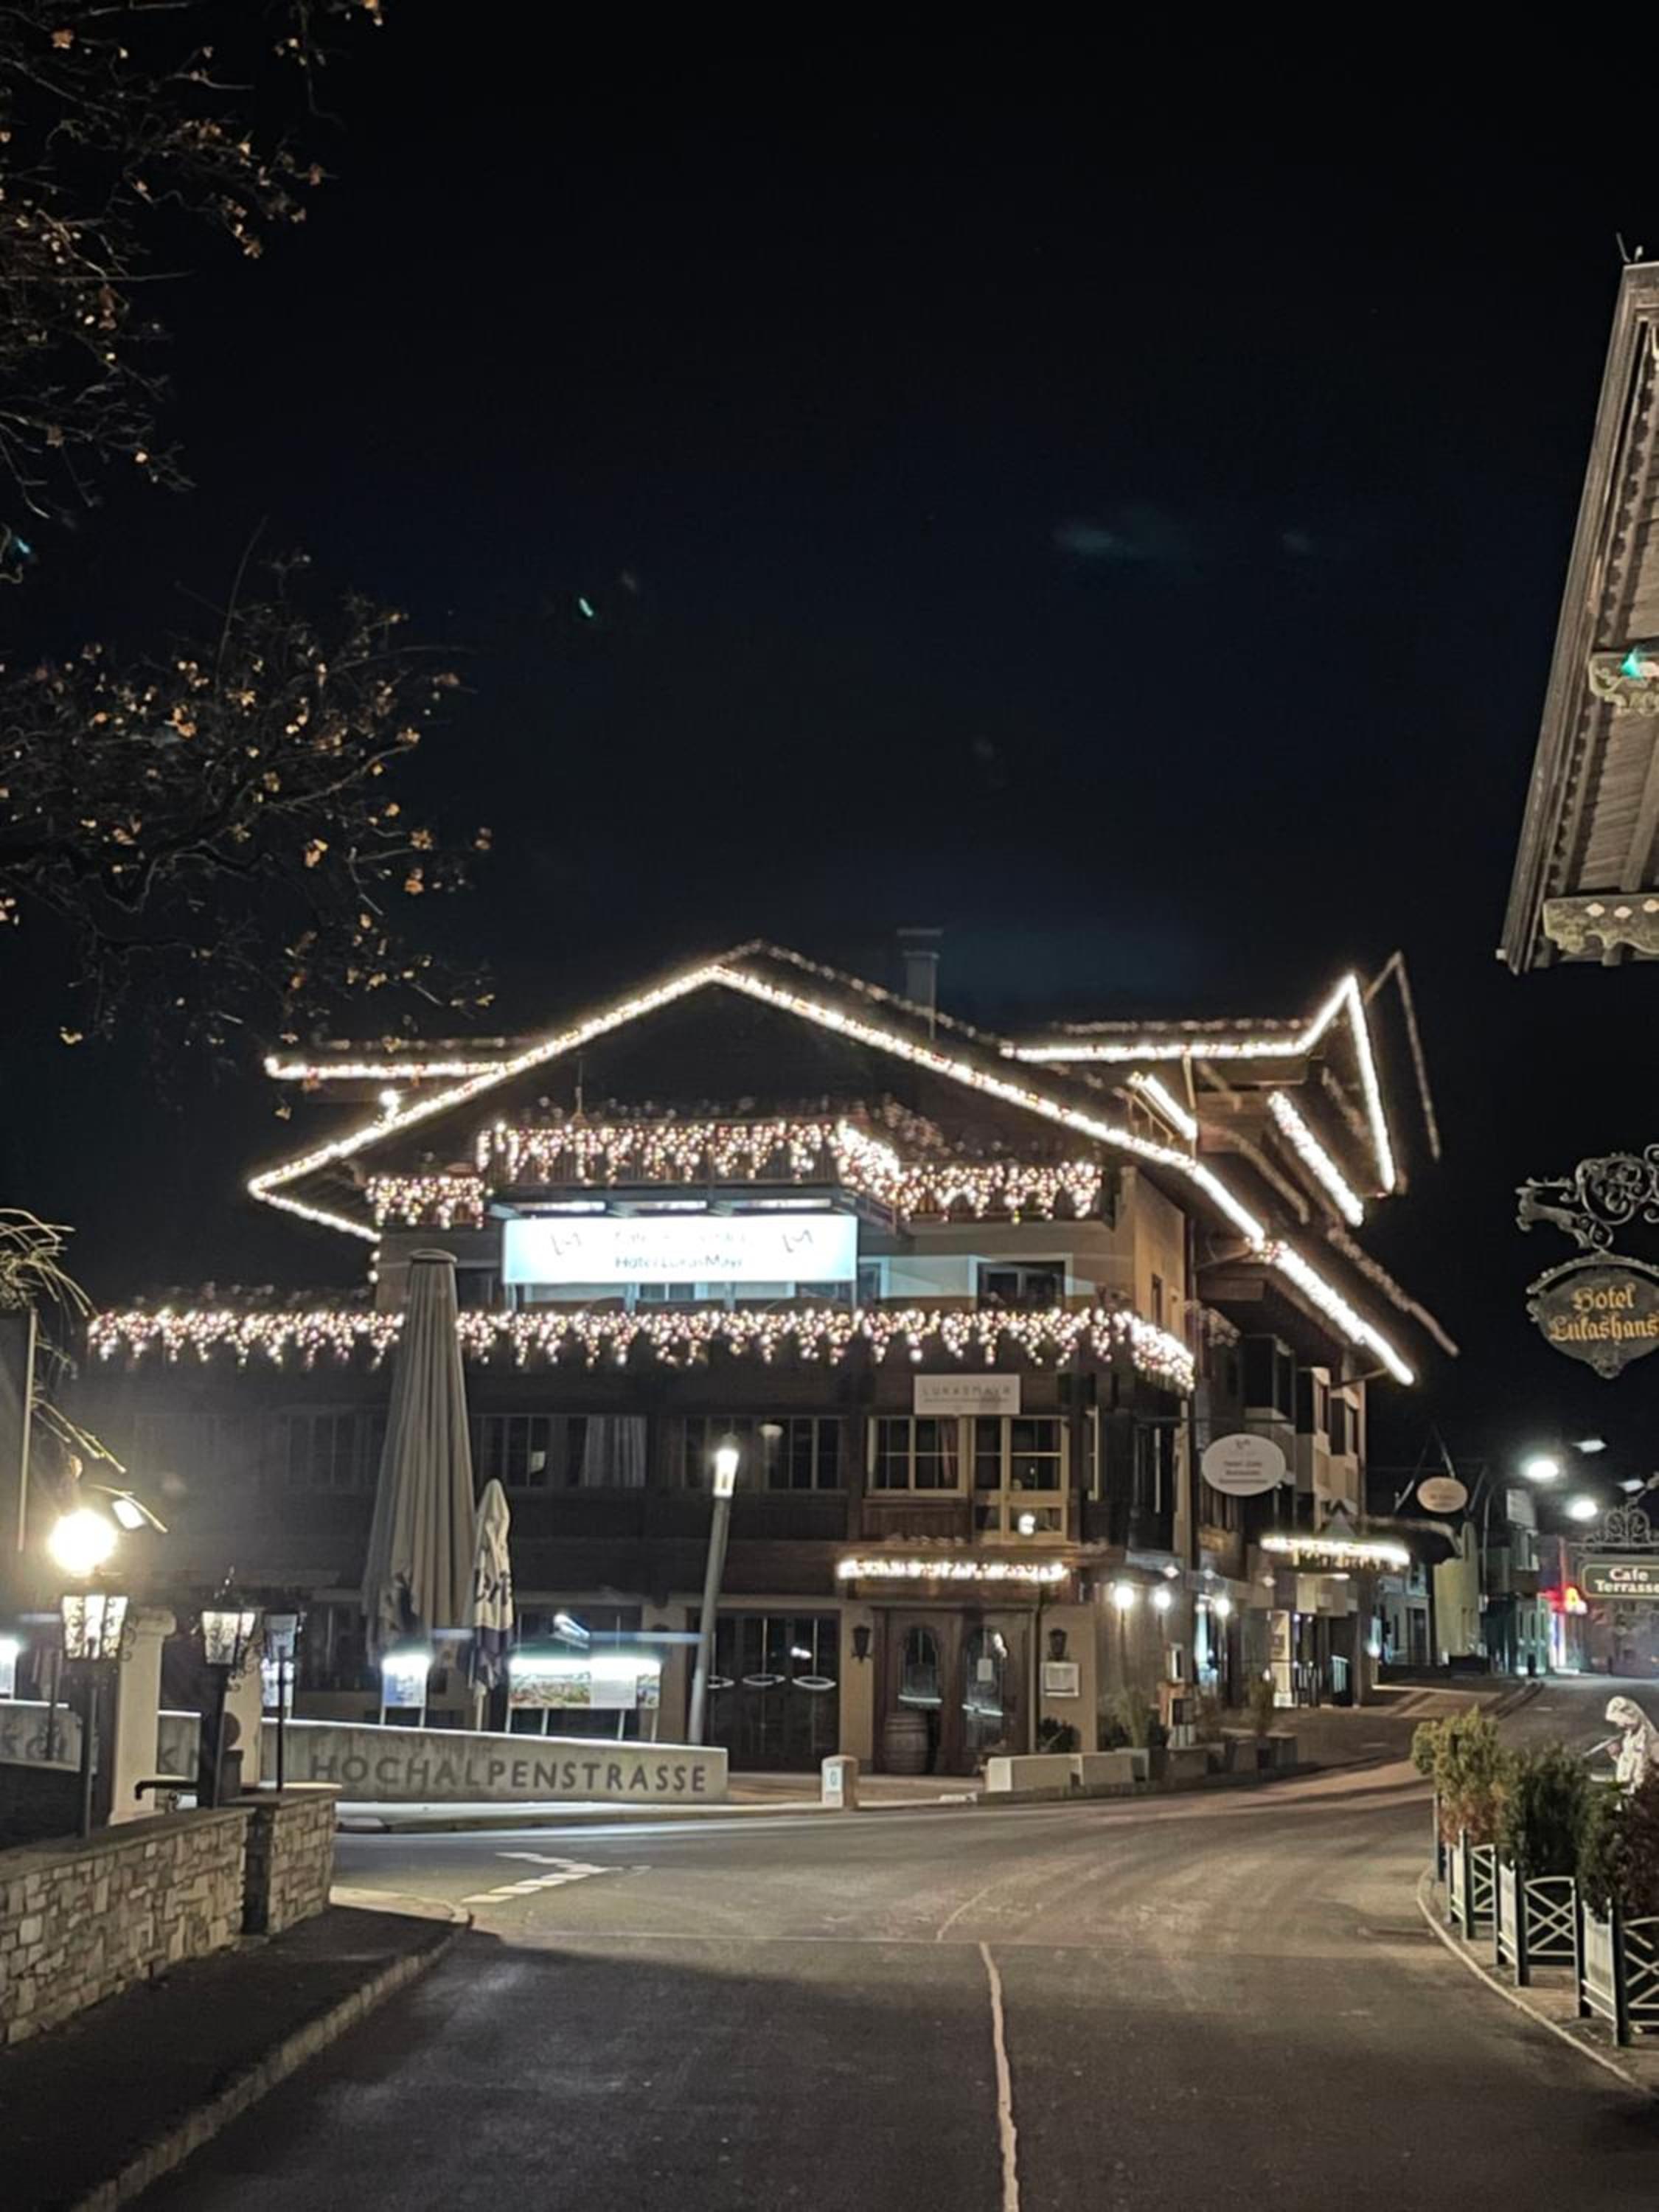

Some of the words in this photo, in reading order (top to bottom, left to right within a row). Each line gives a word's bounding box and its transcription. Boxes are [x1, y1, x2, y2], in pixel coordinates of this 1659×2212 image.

[1571, 1281, 1636, 1312] Hotel
[1609, 1568, 1649, 1582] Cafe
[309, 1753, 706, 1793] HOCHALPENSTRASSE
